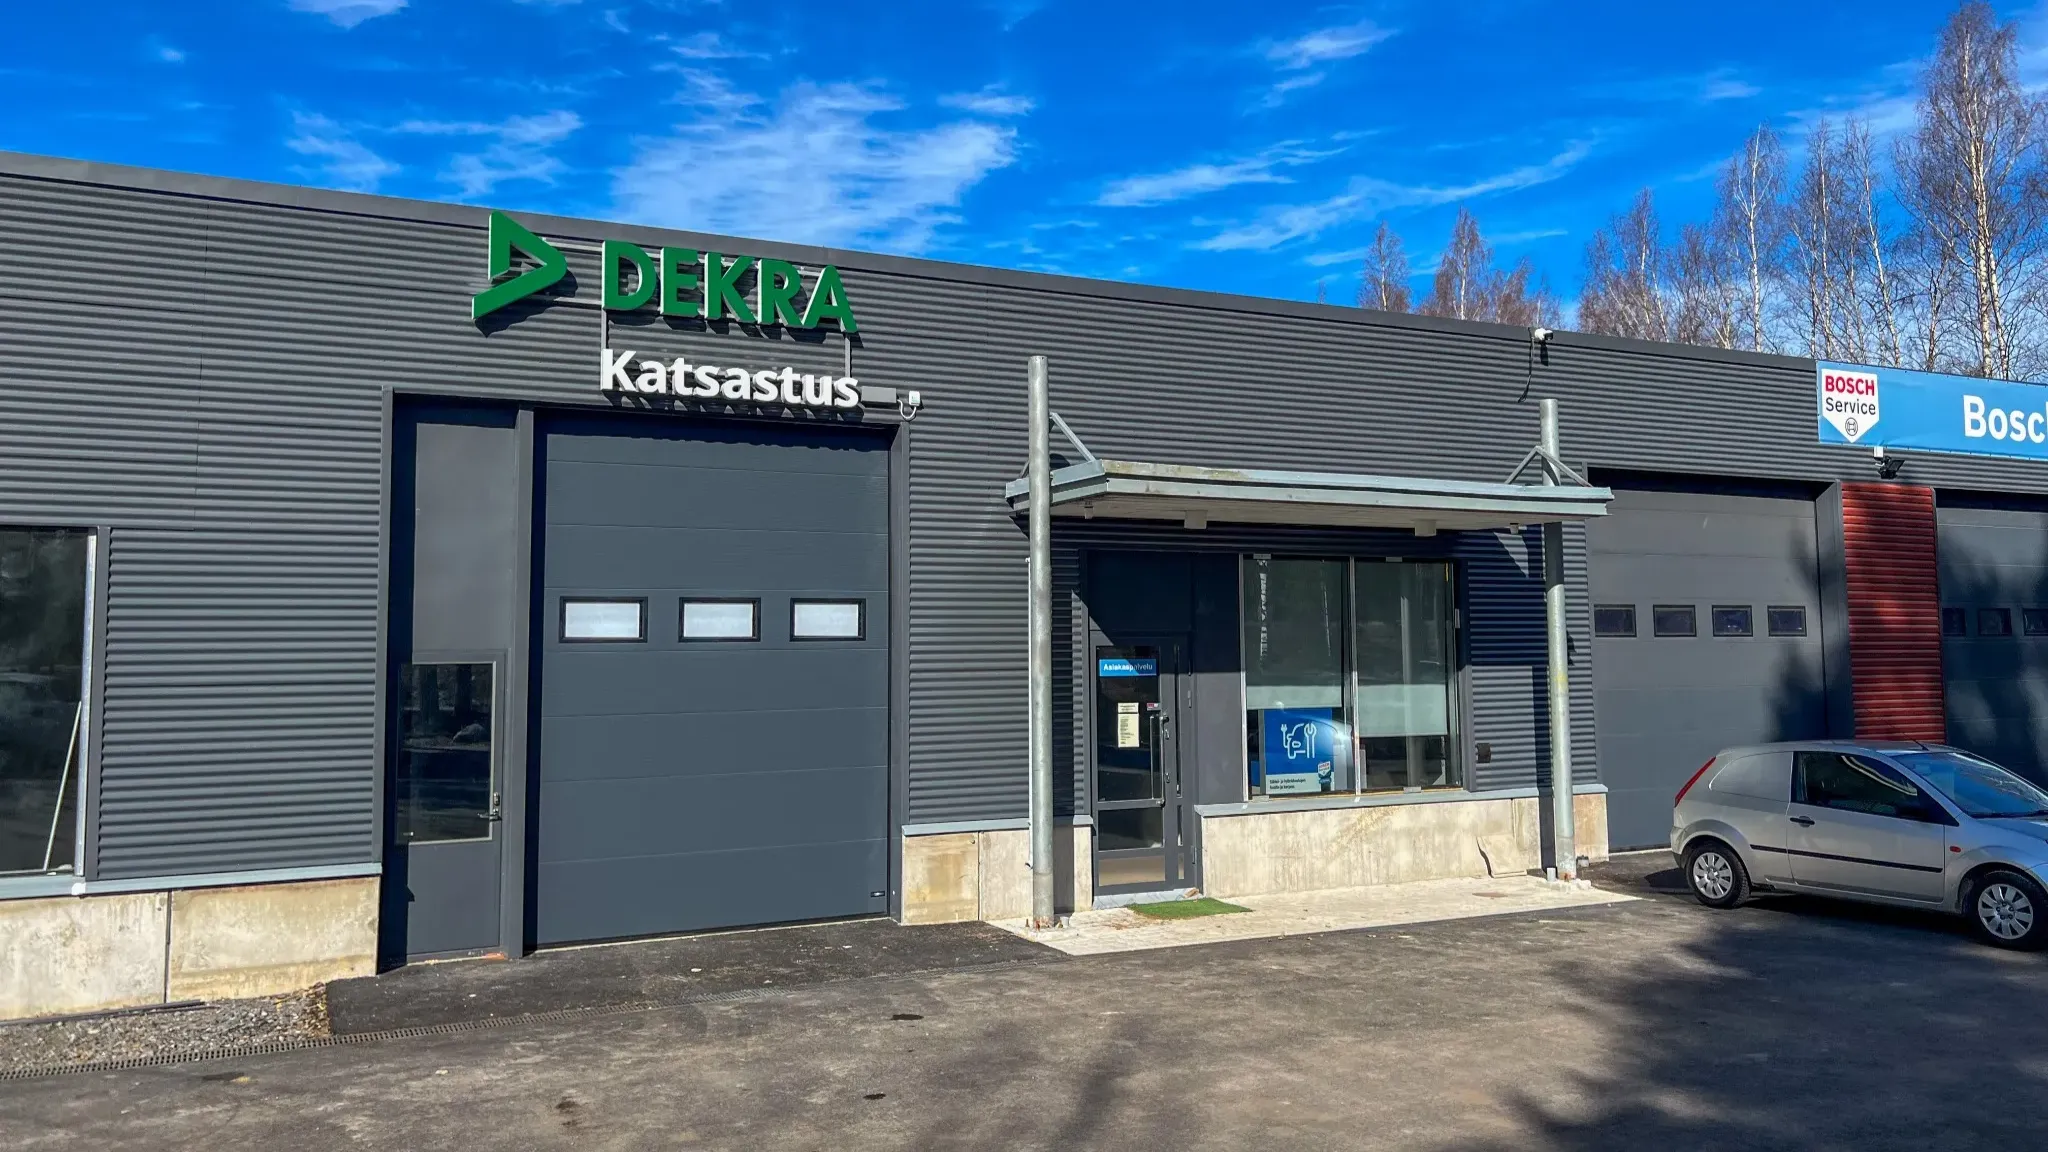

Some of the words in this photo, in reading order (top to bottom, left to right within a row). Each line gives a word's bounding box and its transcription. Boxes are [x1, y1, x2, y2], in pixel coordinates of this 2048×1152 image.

[602, 240, 858, 333] DEKRA
[600, 348, 859, 408] Katsastus
[1825, 375, 1875, 397] BOSCH
[1825, 397, 1876, 415] Service
[1963, 394, 2048, 444] Bosc
[1103, 663, 1153, 672] Asiakaspalvelu
